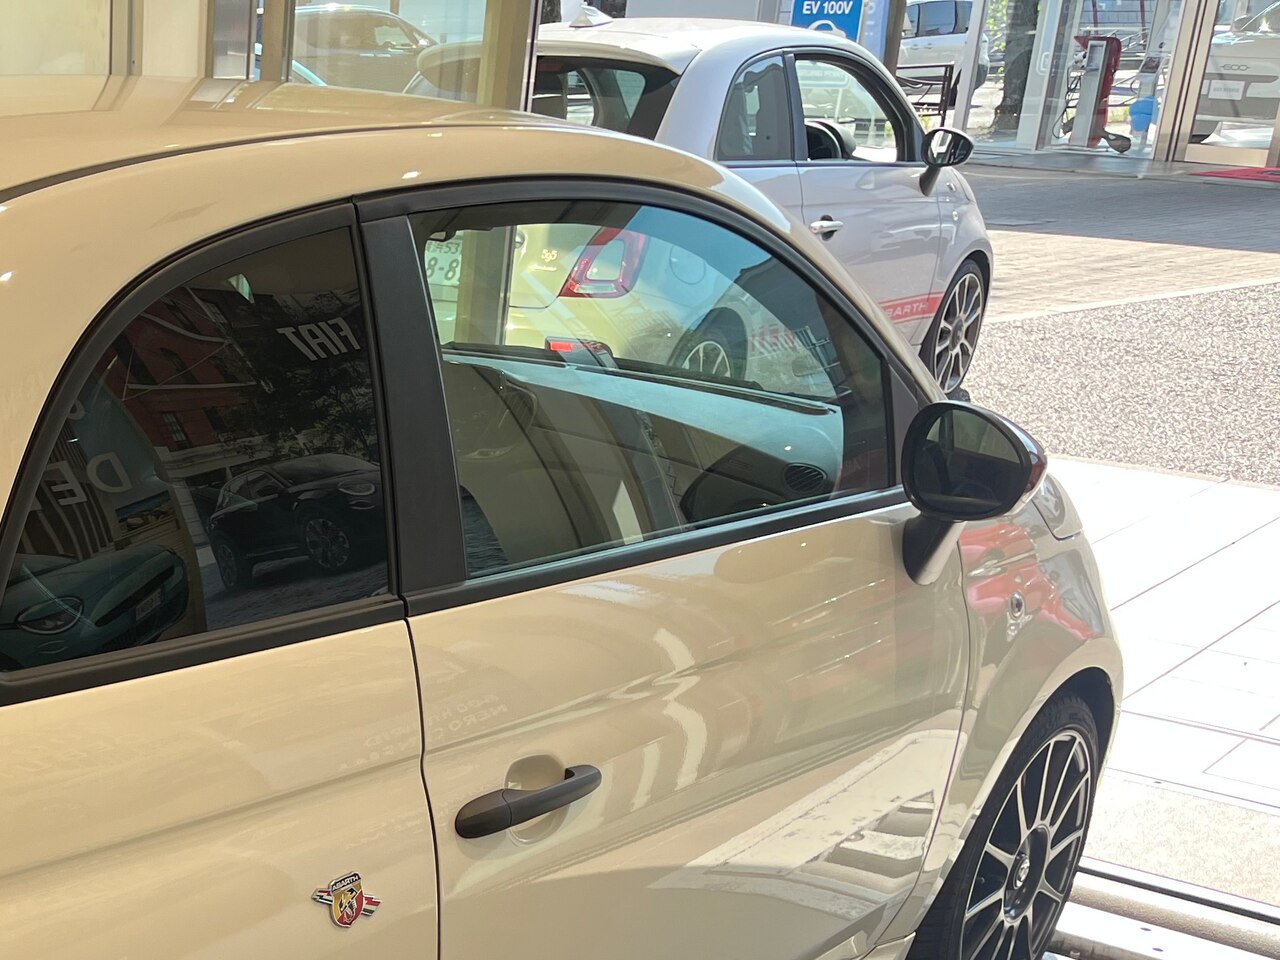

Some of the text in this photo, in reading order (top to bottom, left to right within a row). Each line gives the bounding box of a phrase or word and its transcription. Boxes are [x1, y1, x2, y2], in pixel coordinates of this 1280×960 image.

[802, 1, 854, 15] EV 100V
[886, 302, 928, 317] BARTH
[332, 874, 360, 890] ABARTH
